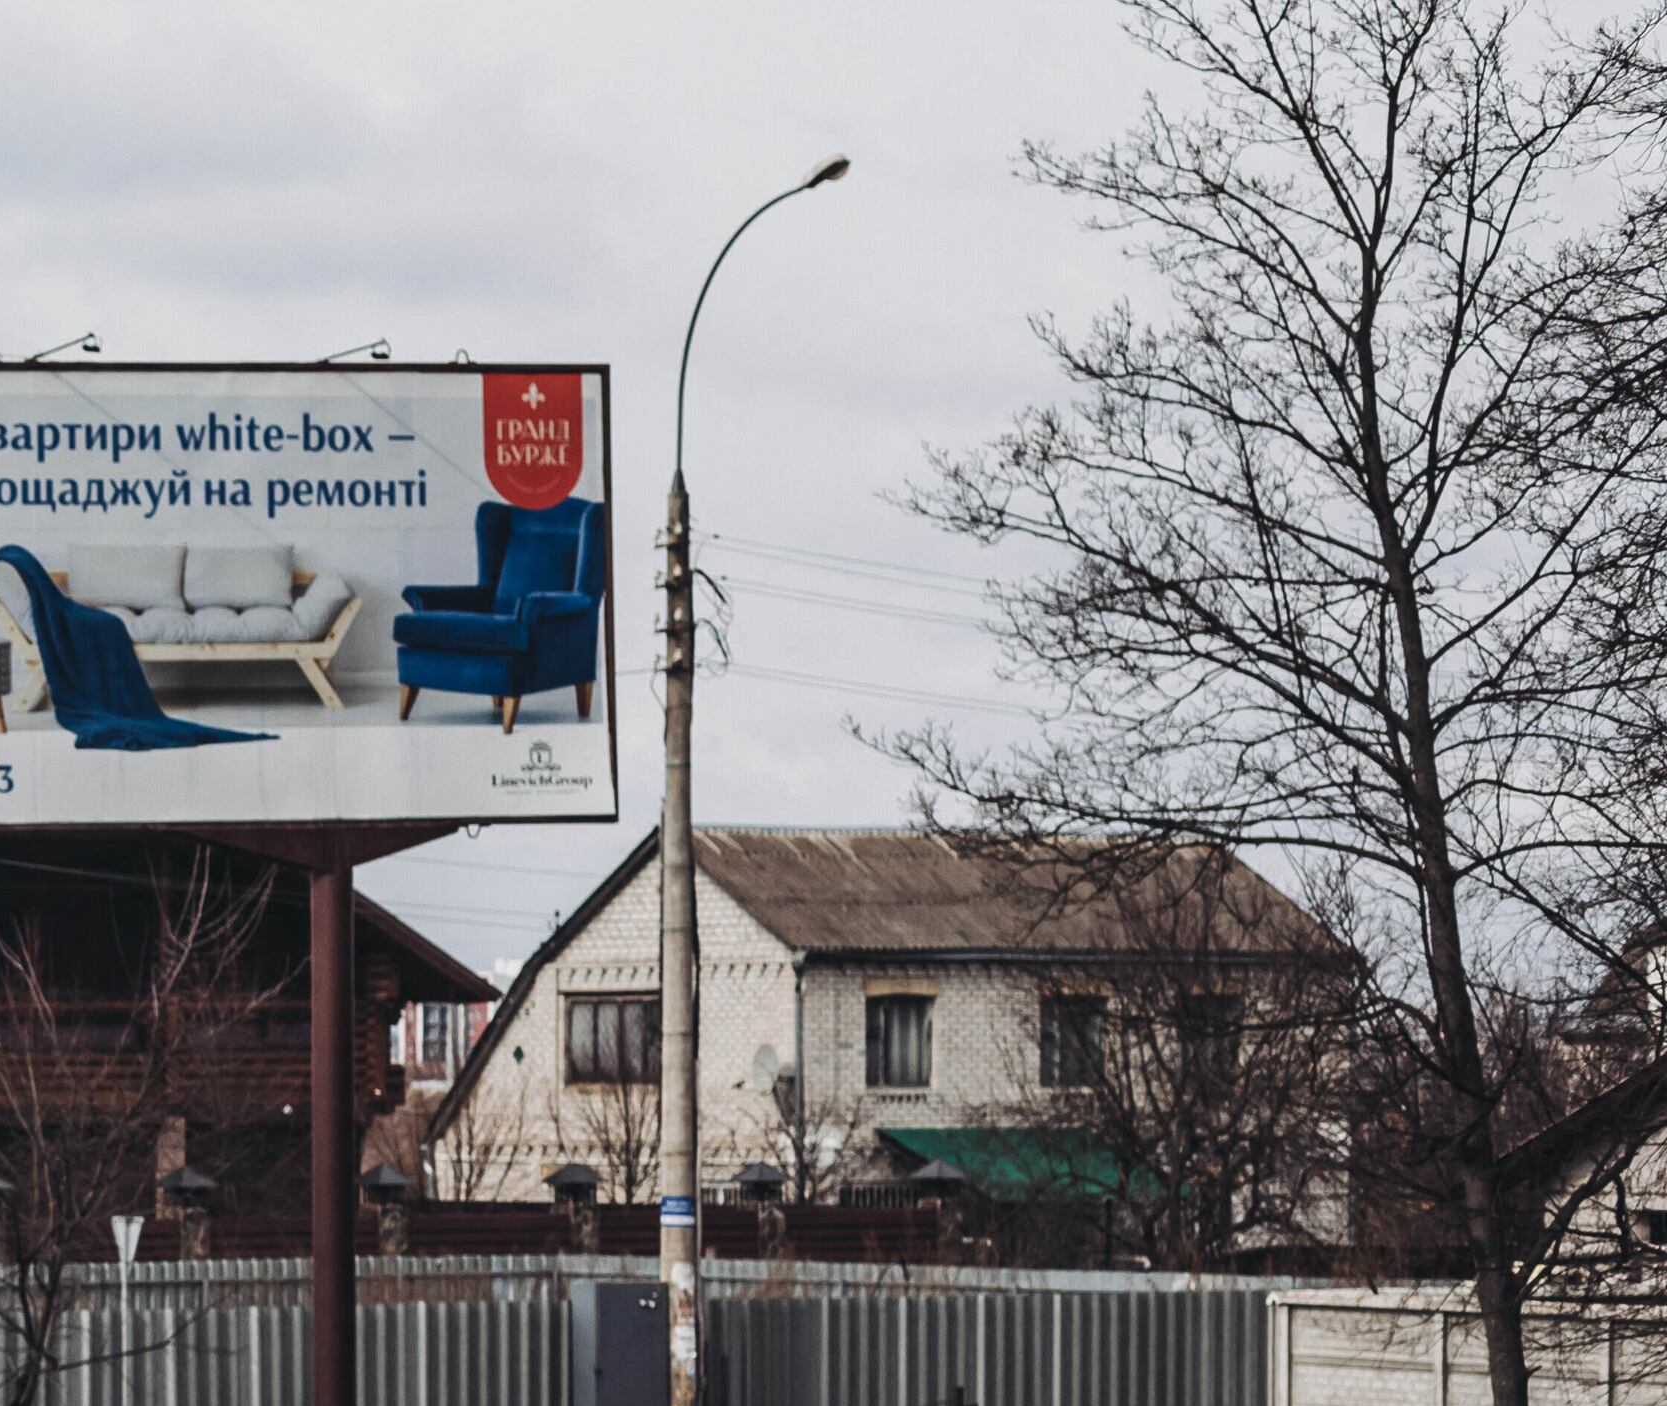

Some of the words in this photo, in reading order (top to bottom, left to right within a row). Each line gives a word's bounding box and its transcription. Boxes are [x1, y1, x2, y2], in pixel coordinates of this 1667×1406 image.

[175, 412, 375, 452] white-box
[496, 418, 570, 445] ГРАНД
[497, 443, 568, 466] БУРЖЕ
[204, 477, 252, 507] на
[267, 469, 427, 519] ремонті
